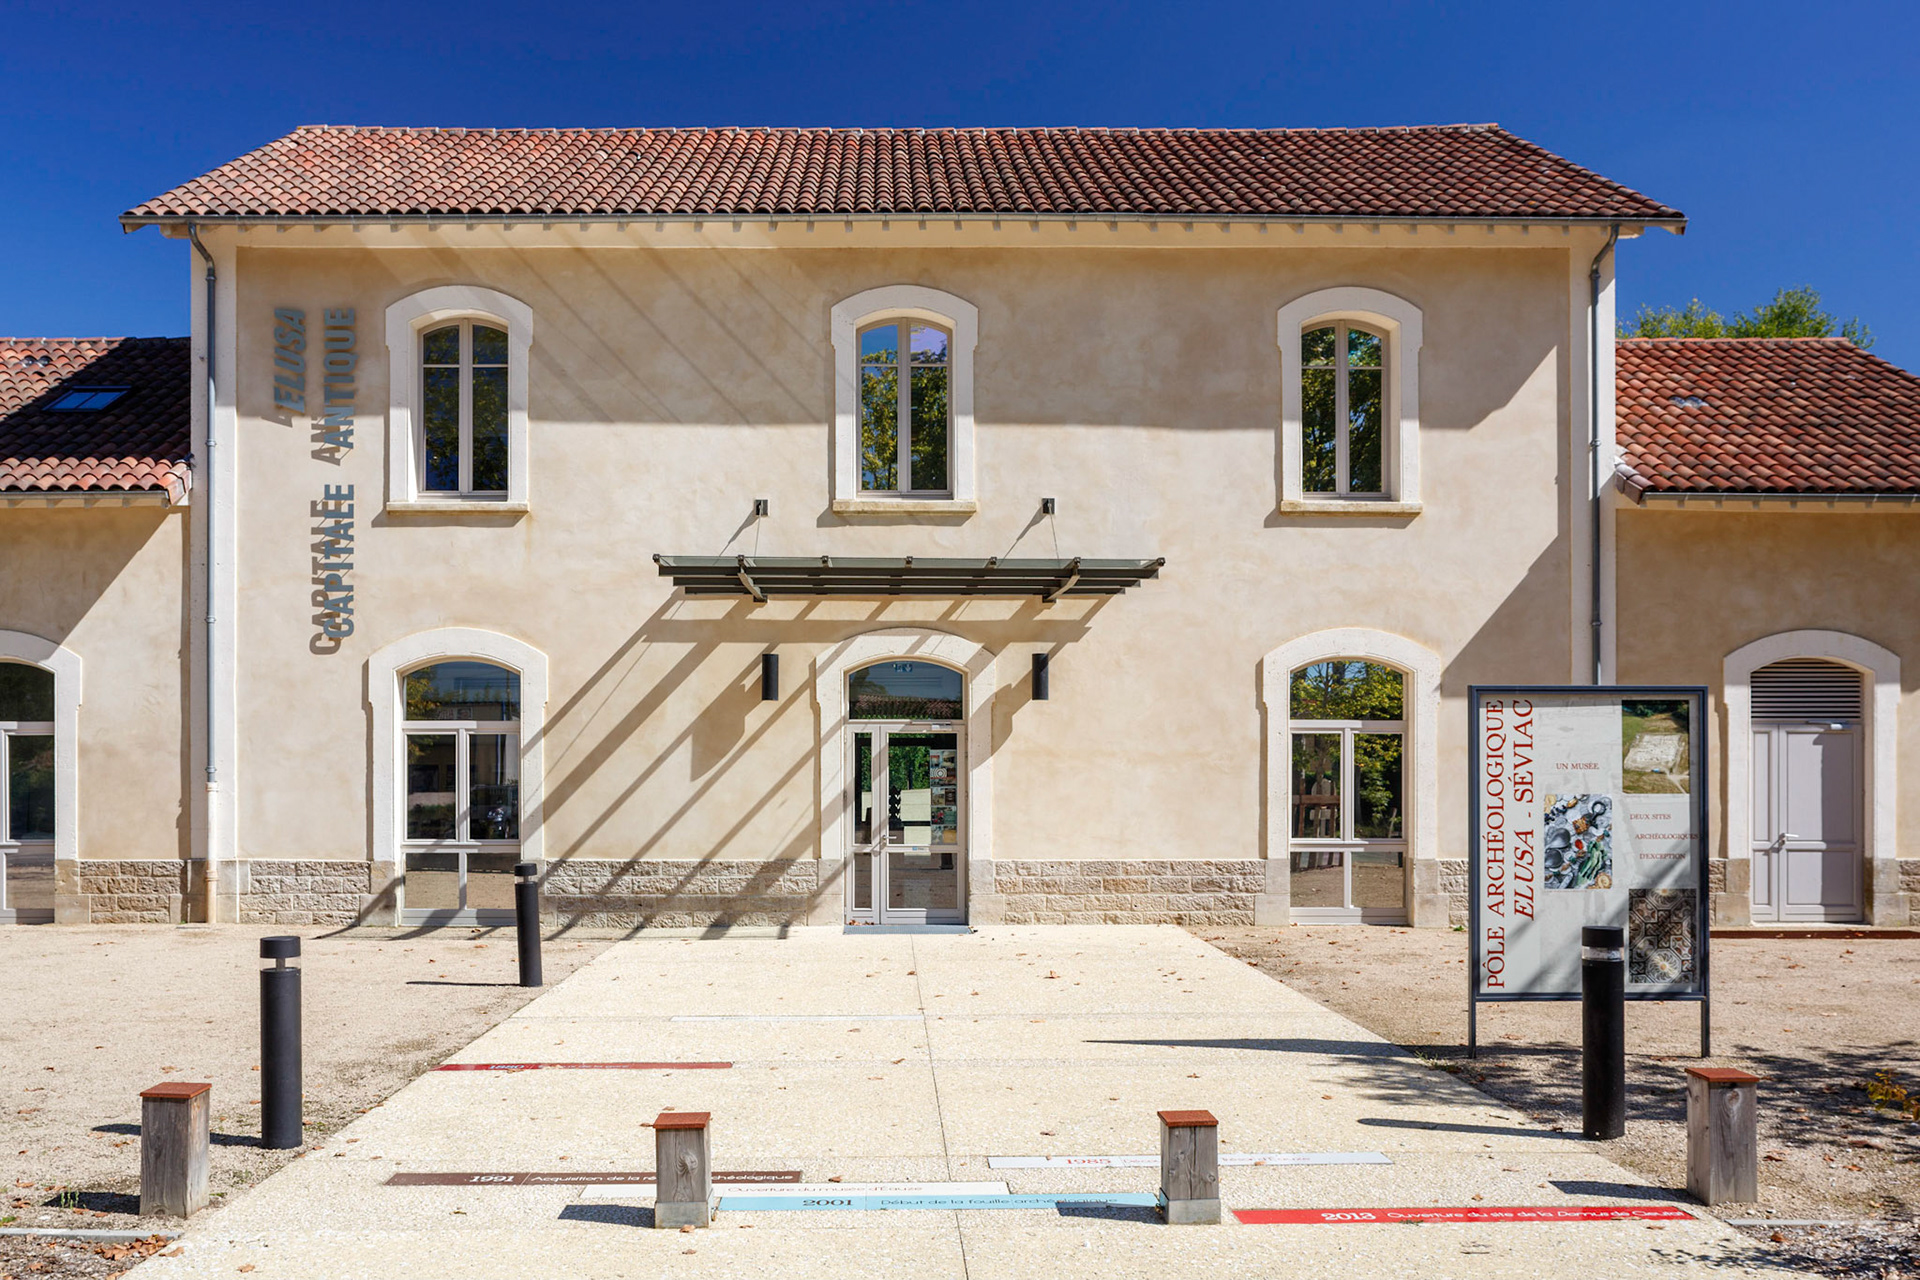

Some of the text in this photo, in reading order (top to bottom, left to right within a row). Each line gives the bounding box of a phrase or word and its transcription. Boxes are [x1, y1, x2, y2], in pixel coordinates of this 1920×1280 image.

[273, 307, 306, 414] ELUSA
[323, 307, 357, 638] CAPITALE ANTIQUE
[1507, 699, 1534, 804] SÉVIAC
[1571, 762, 1599, 770] MUSÉE
[1482, 700, 1507, 988] PÔLE ARCHÉOLOGIQUE
[1635, 833, 1699, 841] ARCHÉOLOGIQUES
[1513, 829, 1535, 921] ELUSA
[469, 1175, 515, 1183] 1991
[1014, 1197, 1118, 1205] archélogique
[1320, 1212, 1377, 1221] 2013
